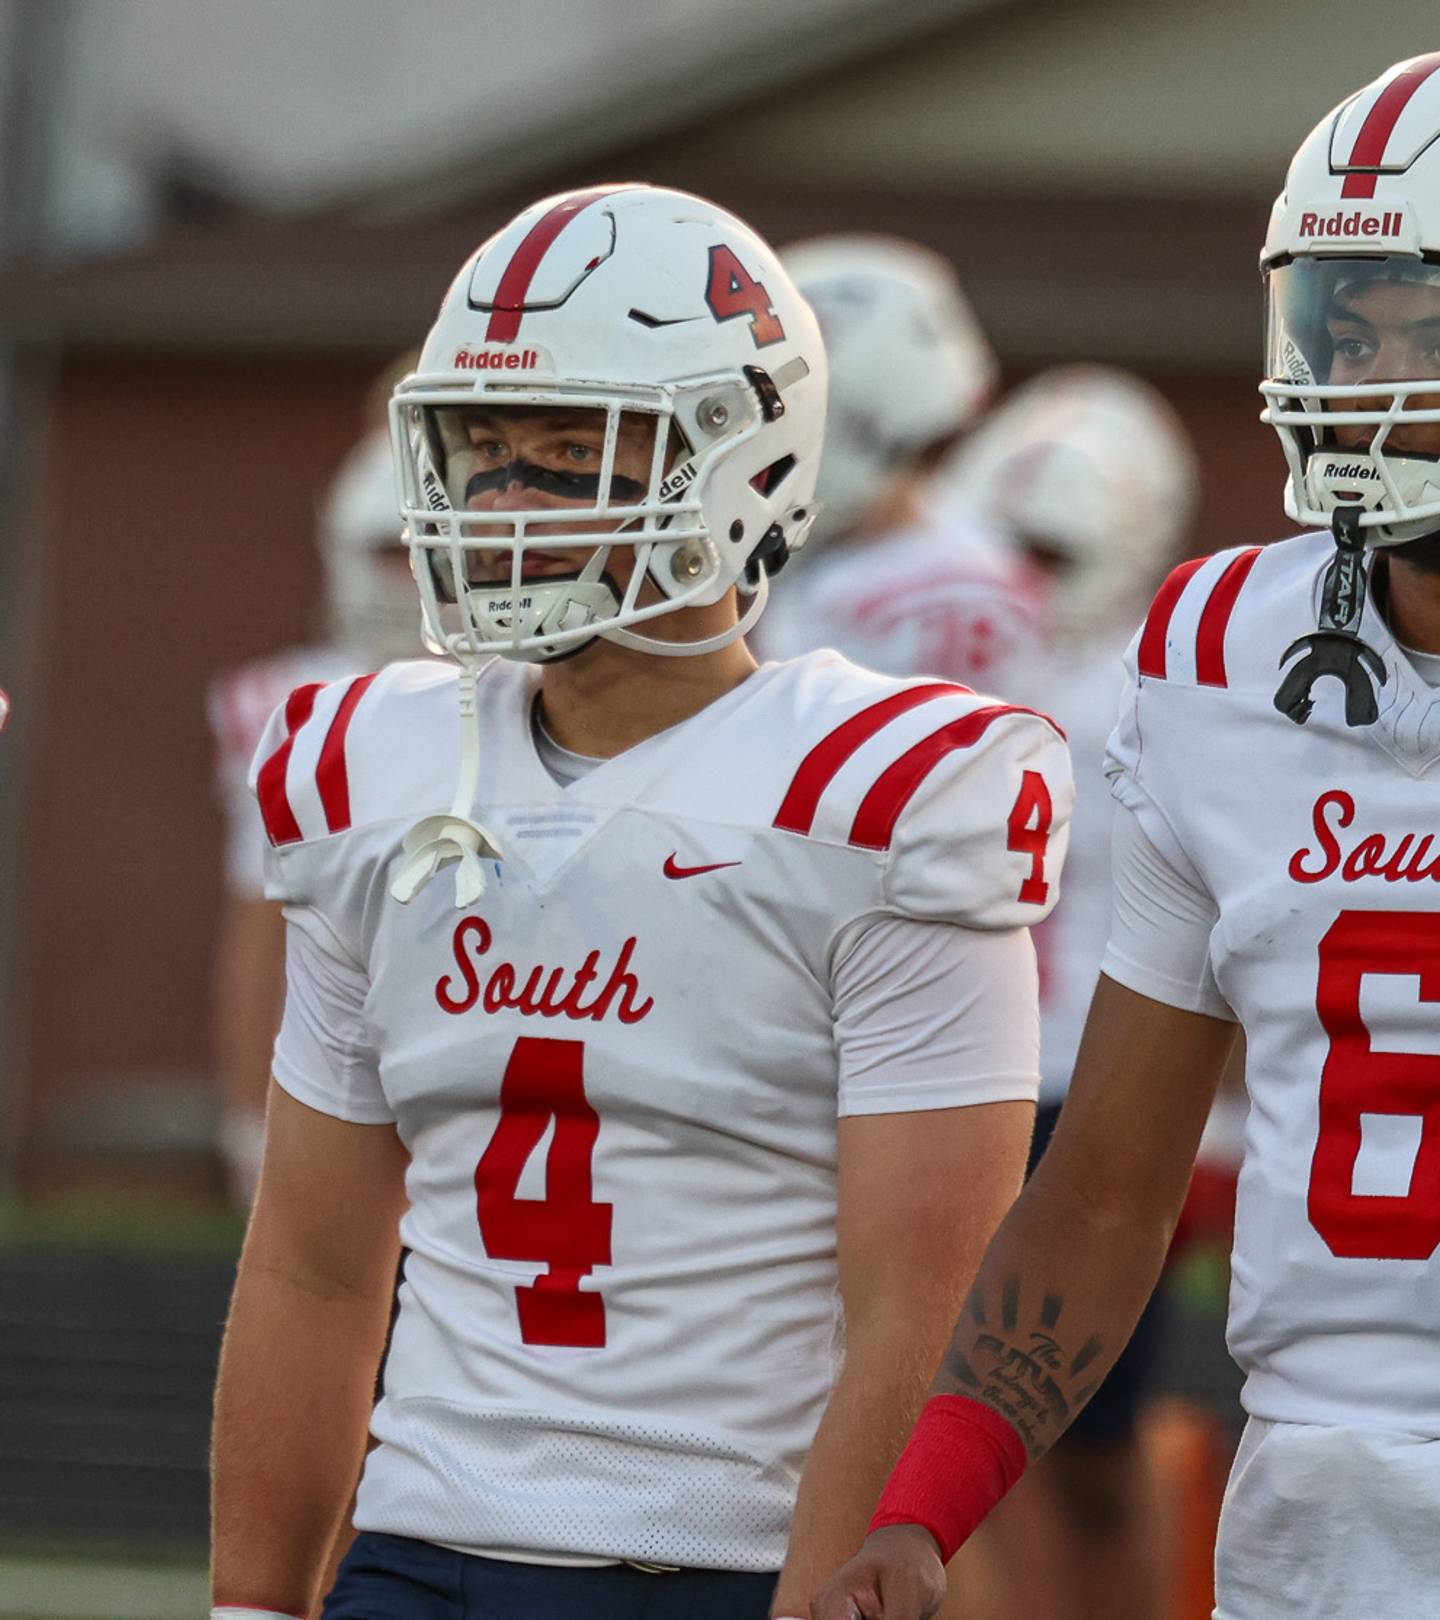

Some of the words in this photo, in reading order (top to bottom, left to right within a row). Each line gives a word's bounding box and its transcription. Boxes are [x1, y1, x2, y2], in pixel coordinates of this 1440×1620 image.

[1299, 212, 1403, 237] Riddell
[704, 243, 786, 350] 4
[454, 350, 538, 369] Riddell
[659, 462, 697, 498] dell
[1006, 770, 1053, 905] 4
[435, 915, 654, 1024] South
[474, 1035, 613, 1348] 4
